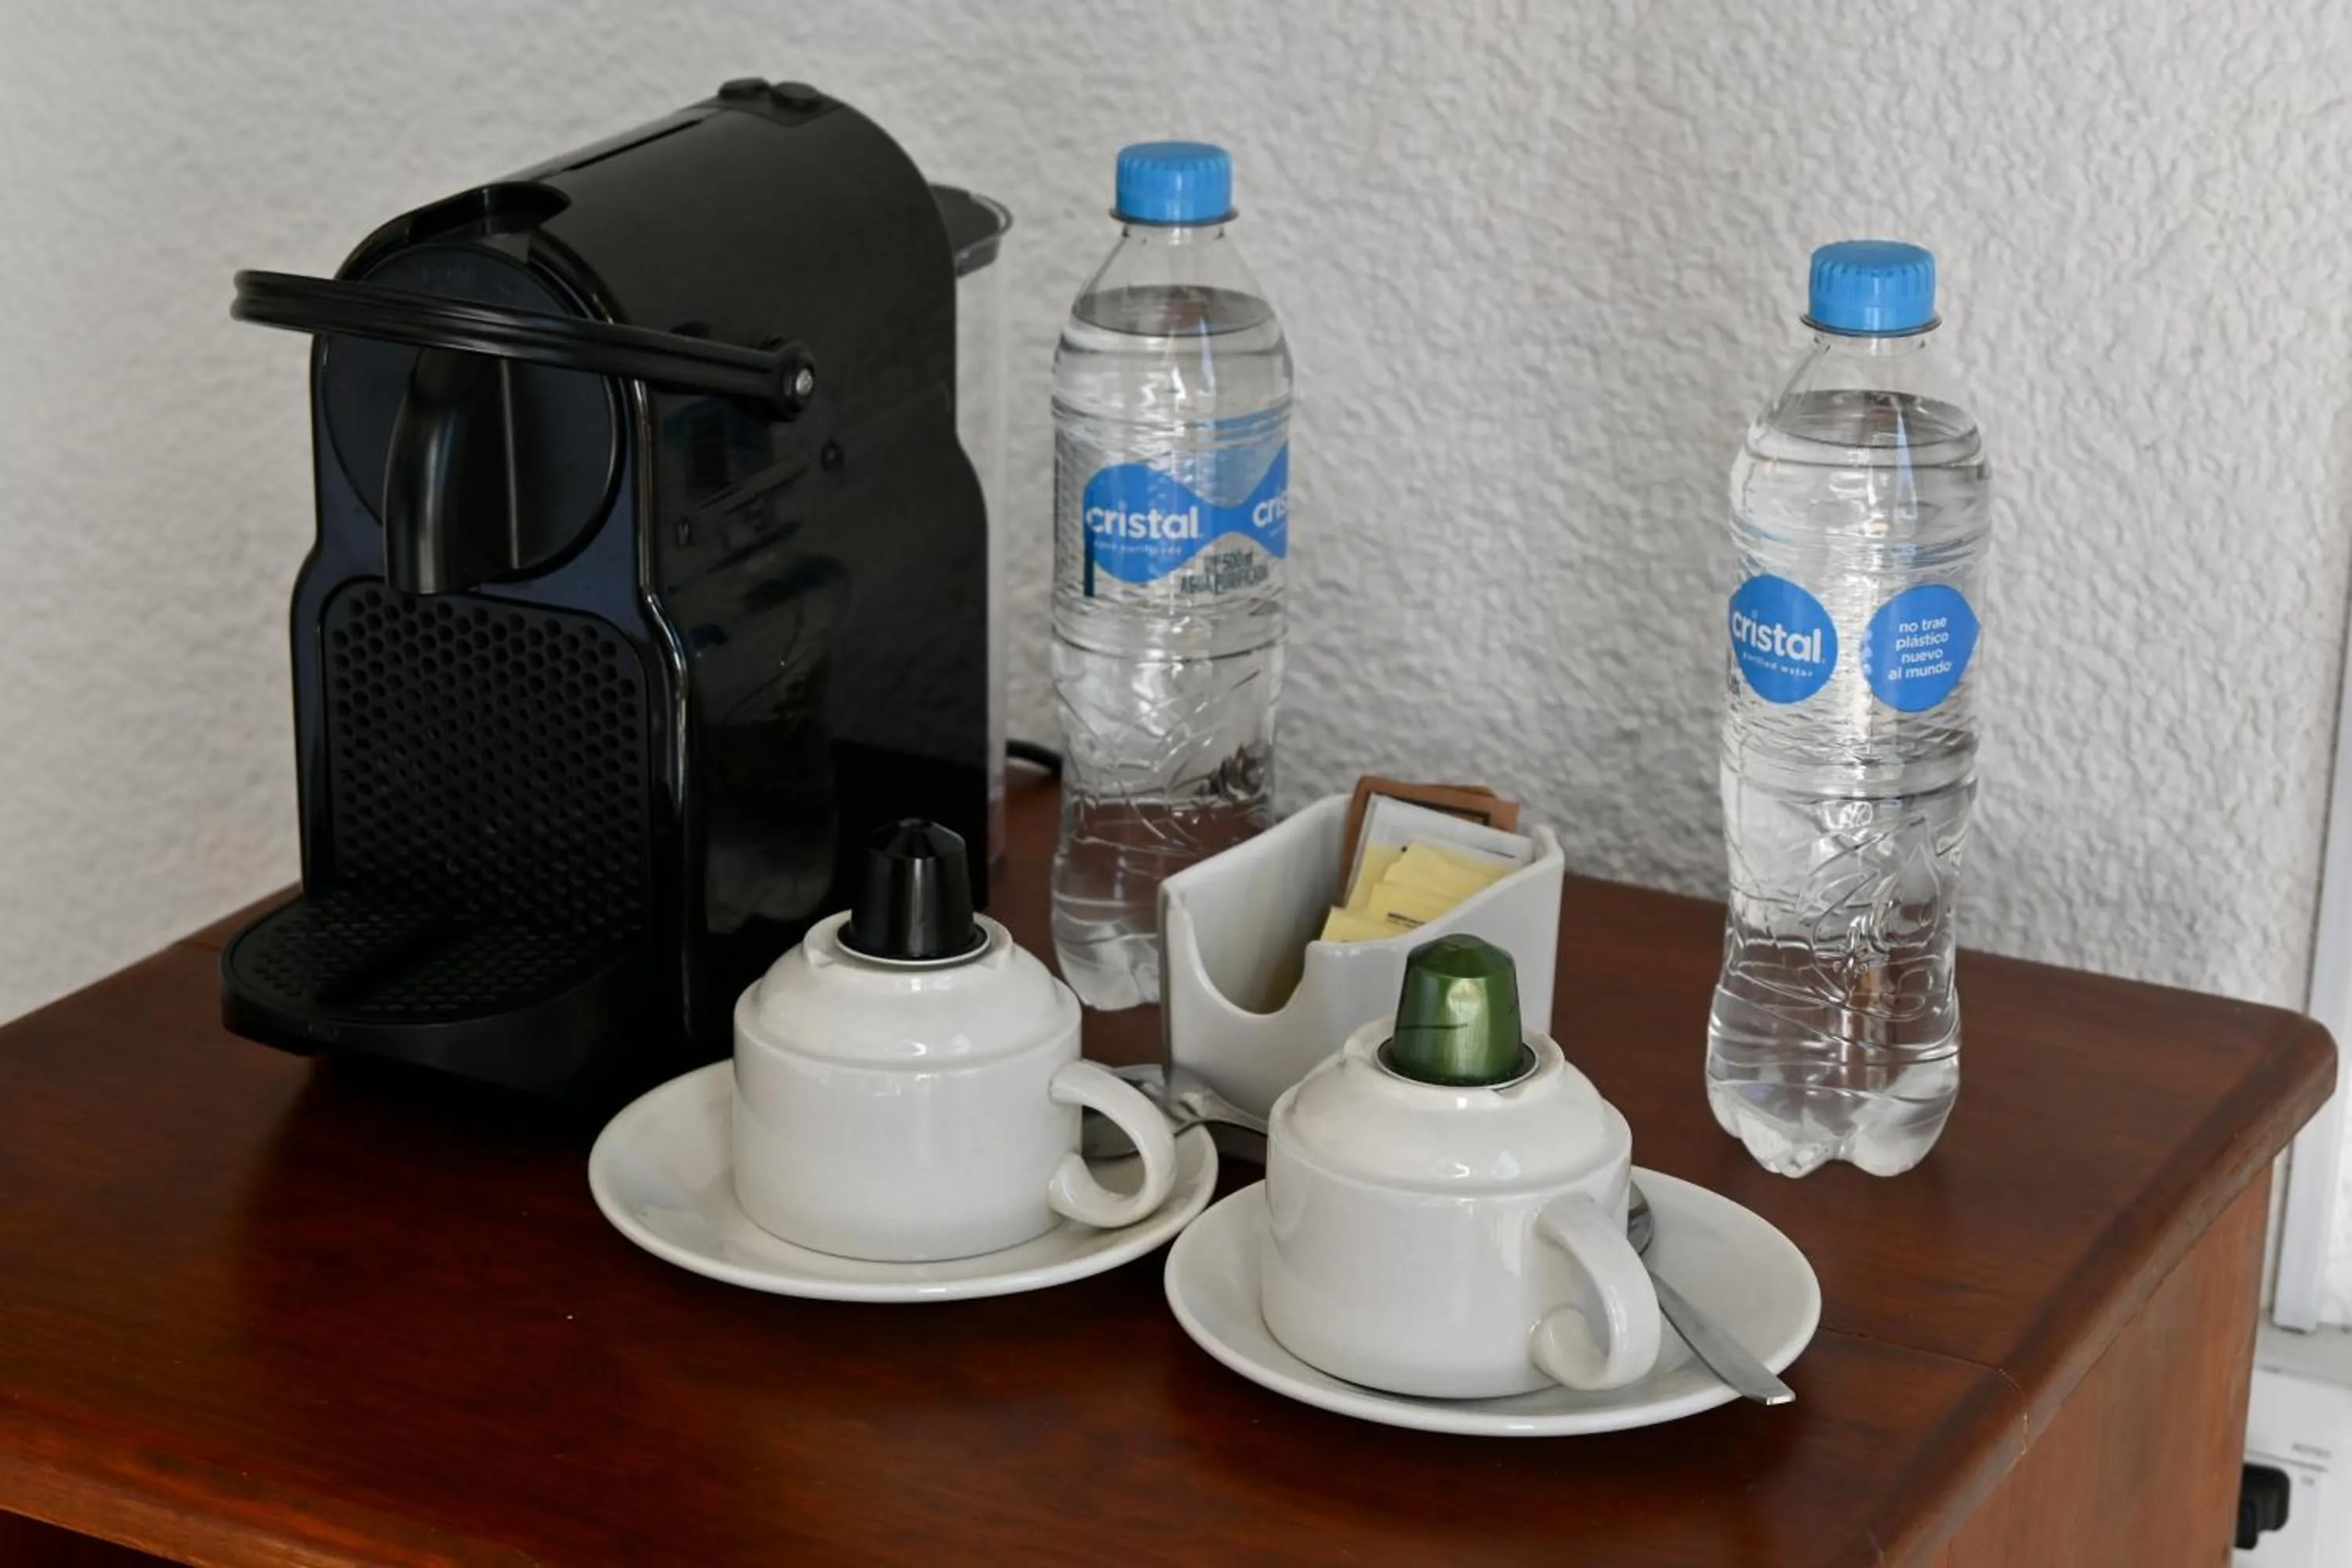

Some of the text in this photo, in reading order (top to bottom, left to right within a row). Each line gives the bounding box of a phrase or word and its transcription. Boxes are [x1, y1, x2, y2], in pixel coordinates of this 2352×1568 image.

[1085, 500, 1199, 539] cristal
[1899, 616, 1947, 633] no trae
[1732, 610, 1822, 664] cristal
[1895, 631, 1950, 652] plástico
[1901, 648, 1944, 664] nuevo
[1887, 666, 1902, 681] al
